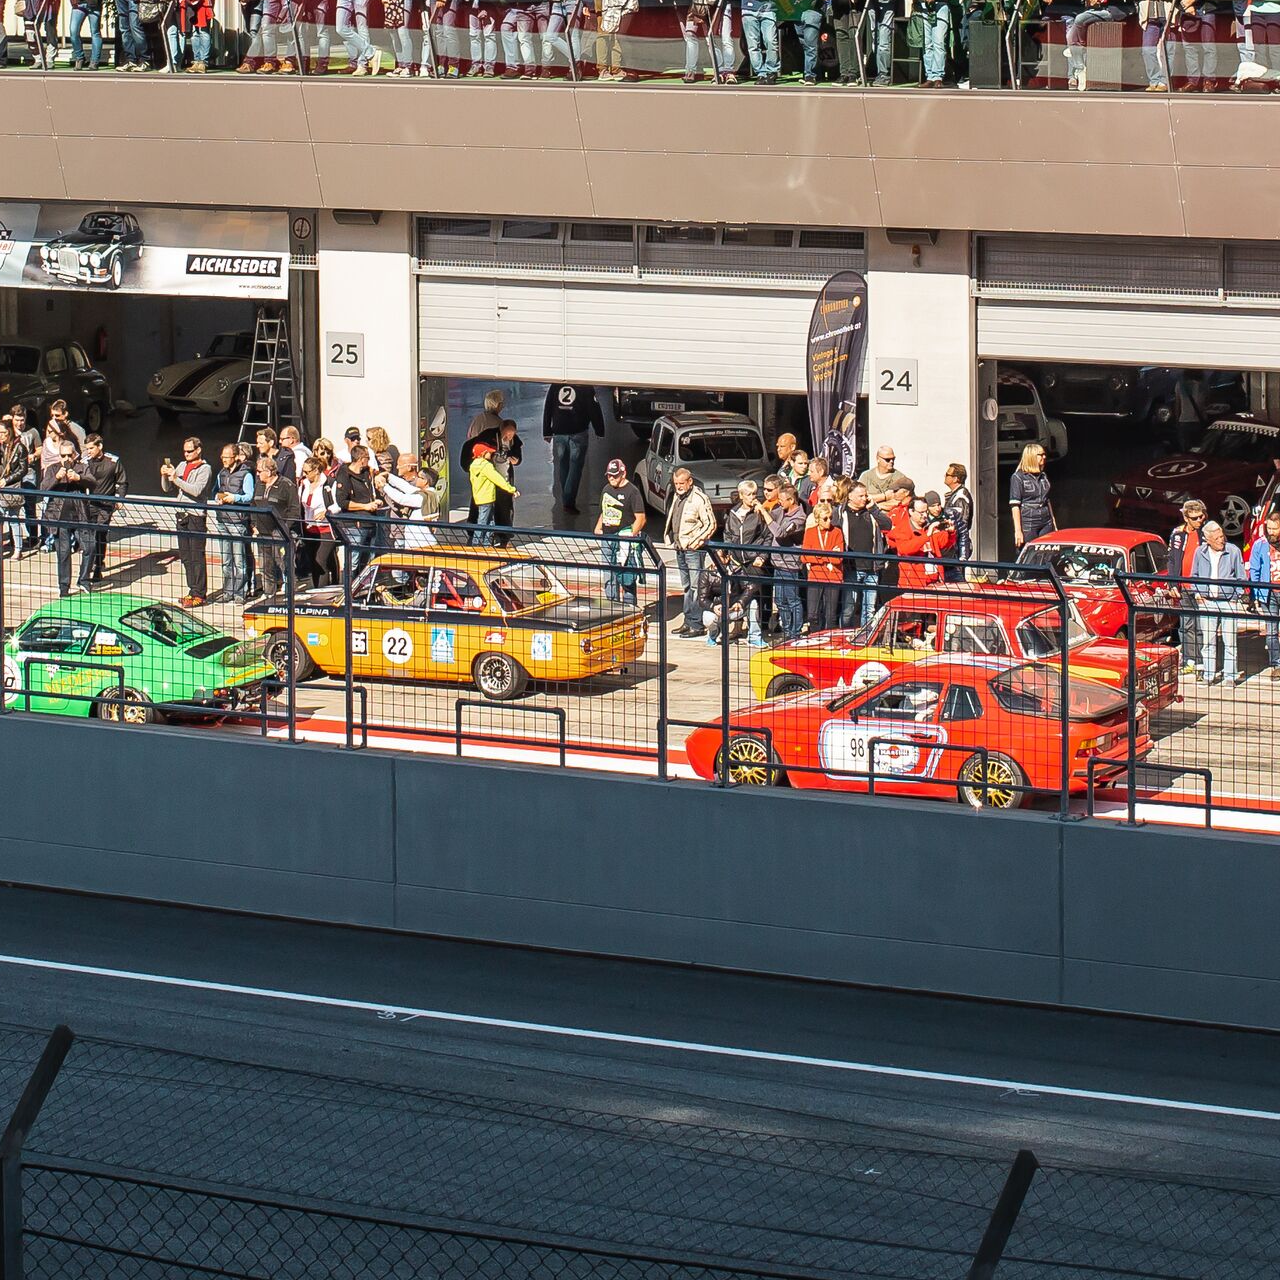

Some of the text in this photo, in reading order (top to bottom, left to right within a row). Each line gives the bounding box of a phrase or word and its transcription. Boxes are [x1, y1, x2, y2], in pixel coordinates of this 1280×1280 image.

[189, 257, 278, 274] AICHLSEDER
[331, 343, 359, 365] 25
[880, 369, 913, 392] 24
[561, 387, 572, 403] 2
[430, 445, 445, 466] 250
[1034, 543, 1116, 556] TEAM FEBAG
[267, 607, 330, 616] BMW ALPINA
[388, 637, 409, 656] 22
[850, 738, 865, 758] 98
